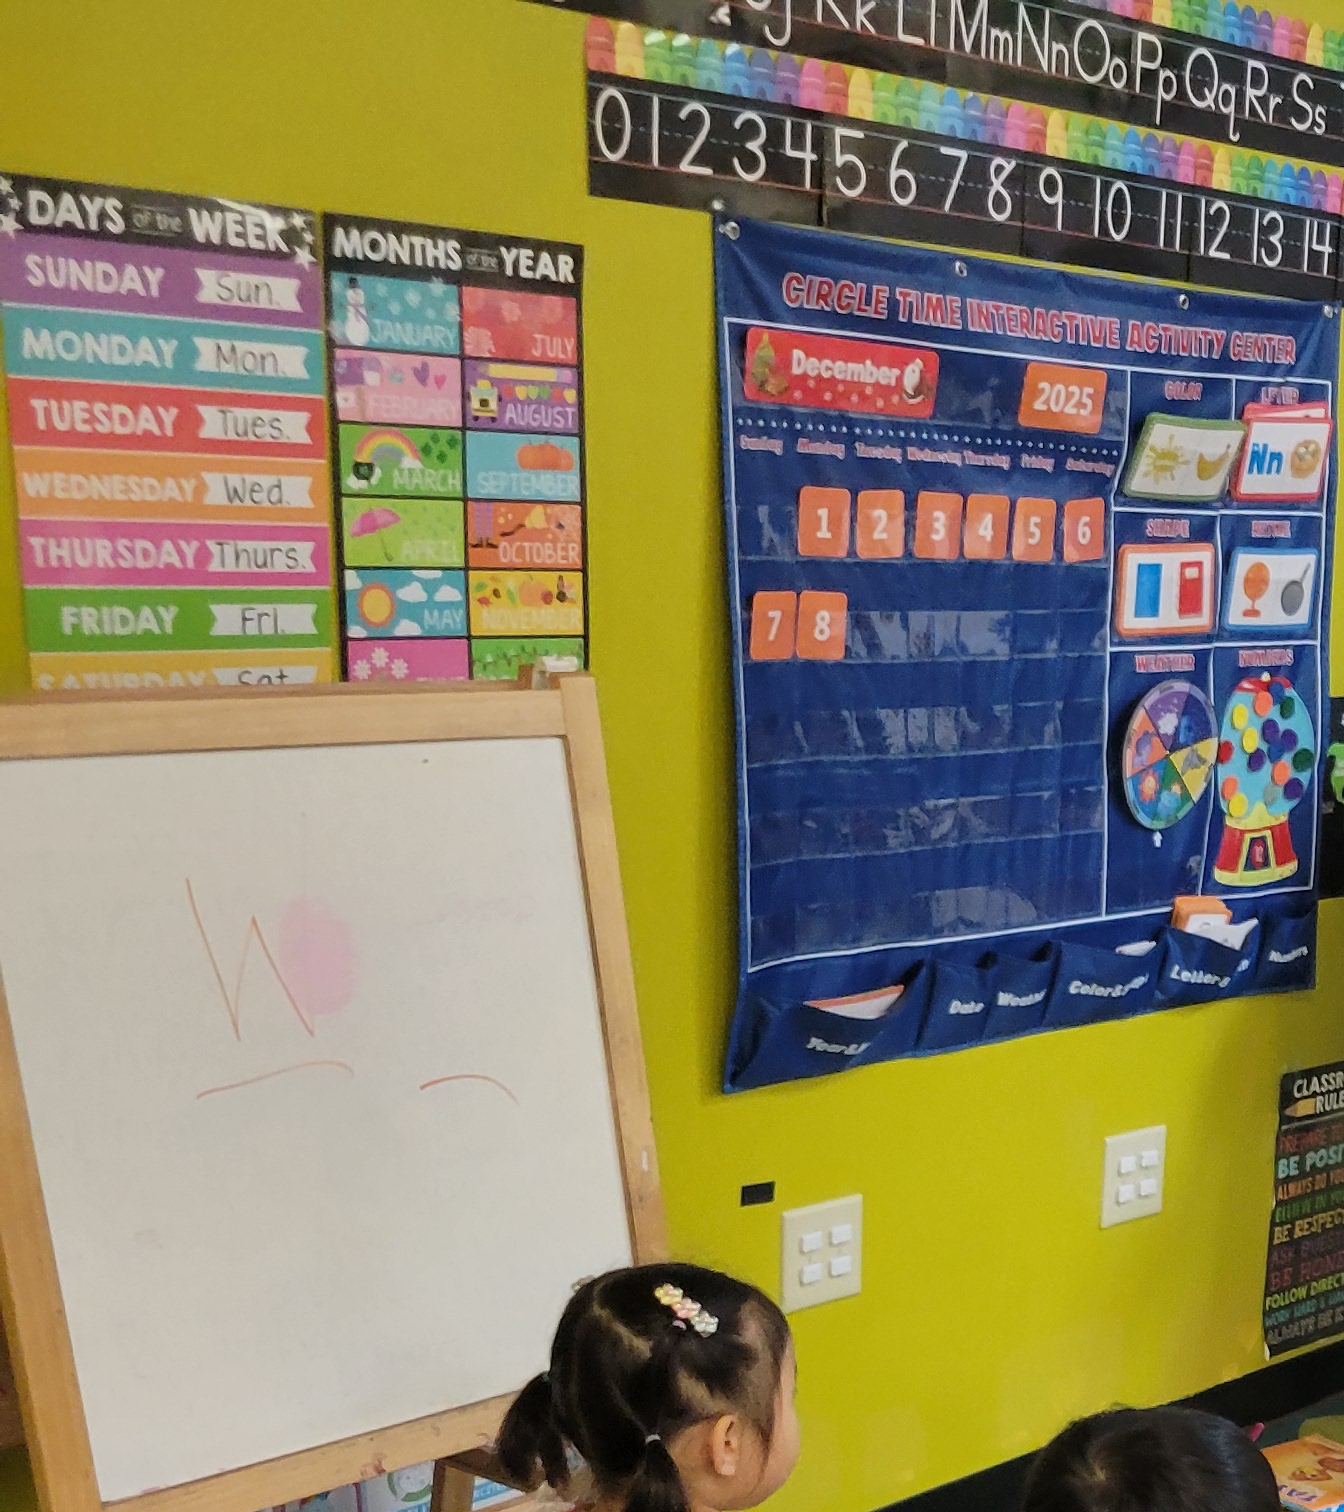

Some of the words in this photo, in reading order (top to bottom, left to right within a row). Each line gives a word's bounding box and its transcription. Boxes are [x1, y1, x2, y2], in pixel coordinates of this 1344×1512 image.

[595, 86, 631, 162] 0
[651, 94, 664, 169] 1
[678, 101, 714, 176] 2
[732, 110, 767, 183] 3
[785, 116, 818, 190] 4
[833, 127, 867, 199] 5
[889, 138, 917, 207] 6
[939, 145, 968, 214] 7
[987, 156, 1017, 222] 8
[1038, 165, 1063, 232] 9
[1093, 175, 1132, 242] 10
[1158, 186, 1184, 253] 11
[1198, 196, 1231, 260] 12
[1252, 206, 1284, 268] 13
[1301, 216, 1334, 278] 14
[27, 189, 126, 235] DAYS
[187, 207, 290, 253] WEEK
[333, 226, 463, 271] MONTHS
[499, 246, 577, 284] YEAR
[24, 253, 166, 298] SUNDAY
[215, 273, 281, 307] Sun.
[369, 318, 456, 347] JANUARY
[782, 271, 889, 320] CIRCLE
[896, 287, 963, 331] TIME
[966, 297, 1121, 350] INTERACTIVE
[1126, 319, 1227, 361] ACTIVITY
[1230, 330, 1296, 365] CENTER
[22, 326, 179, 370] MONDAY
[215, 341, 289, 376] Mon.
[531, 333, 575, 358] JULY
[792, 349, 901, 386] December
[1032, 381, 1095, 416] 2025
[29, 398, 179, 437] TUESDAY
[217, 408, 290, 441] Tues.
[504, 403, 576, 429] AUGUST
[1247, 441, 1284, 476] Nn
[22, 471, 200, 503] WEDNESDAY
[223, 475, 291, 507] Wed.
[393, 468, 461, 491] MARCH
[477, 471, 580, 495] SEPTEMBER
[816, 508, 829, 538] 1
[872, 509, 887, 539] 2
[931, 510, 946, 539] 3
[978, 511, 995, 540] 4
[1028, 516, 1041, 545] 5
[1077, 516, 1091, 543] 6
[27, 536, 200, 570] THURSDAY
[216, 541, 307, 570] Thurs.
[499, 541, 580, 564] OCTOBER
[60, 603, 180, 636] FRIDAY
[423, 609, 464, 630] MAY
[767, 611, 781, 641] 7
[812, 610, 831, 641] 8
[1277, 1155, 1300, 1180] BE
[1273, 1223, 1292, 1245] BE
[1265, 1284, 1308, 1311] FOLLOW
